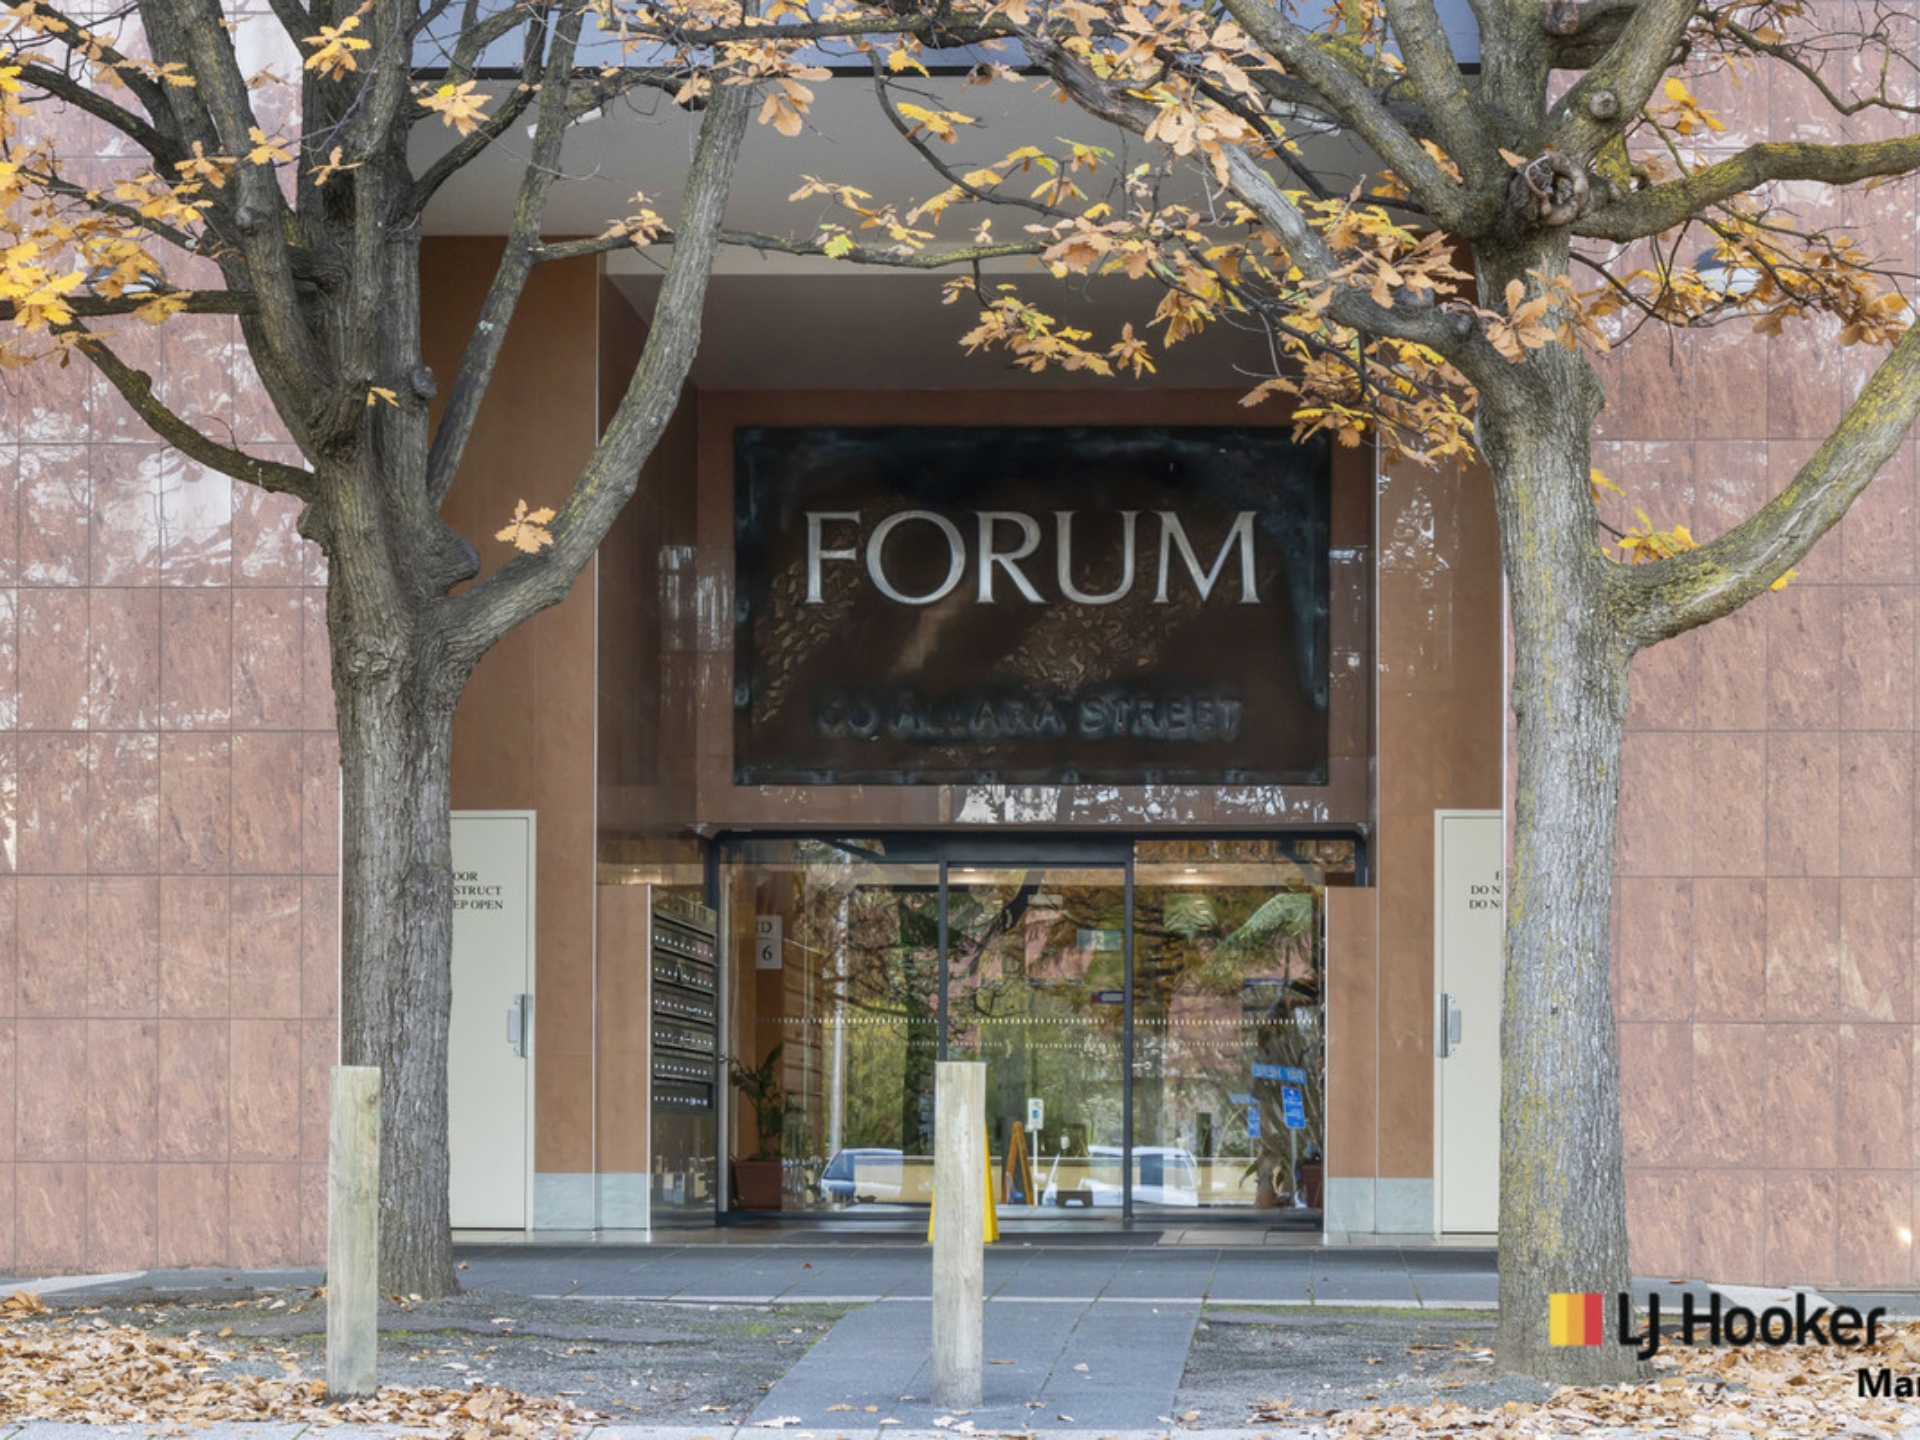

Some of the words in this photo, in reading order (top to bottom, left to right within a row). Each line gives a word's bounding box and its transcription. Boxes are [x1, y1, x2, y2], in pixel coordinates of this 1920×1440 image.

[804, 509, 1261, 604] FORUM
[1079, 697, 1242, 740] STREET
[451, 871, 478, 881] OOR
[453, 885, 503, 896] STRUCT
[1470, 885, 1489, 895] DO
[453, 899, 469, 909] EP
[470, 899, 504, 910] OPEN
[1469, 899, 1488, 909] DO
